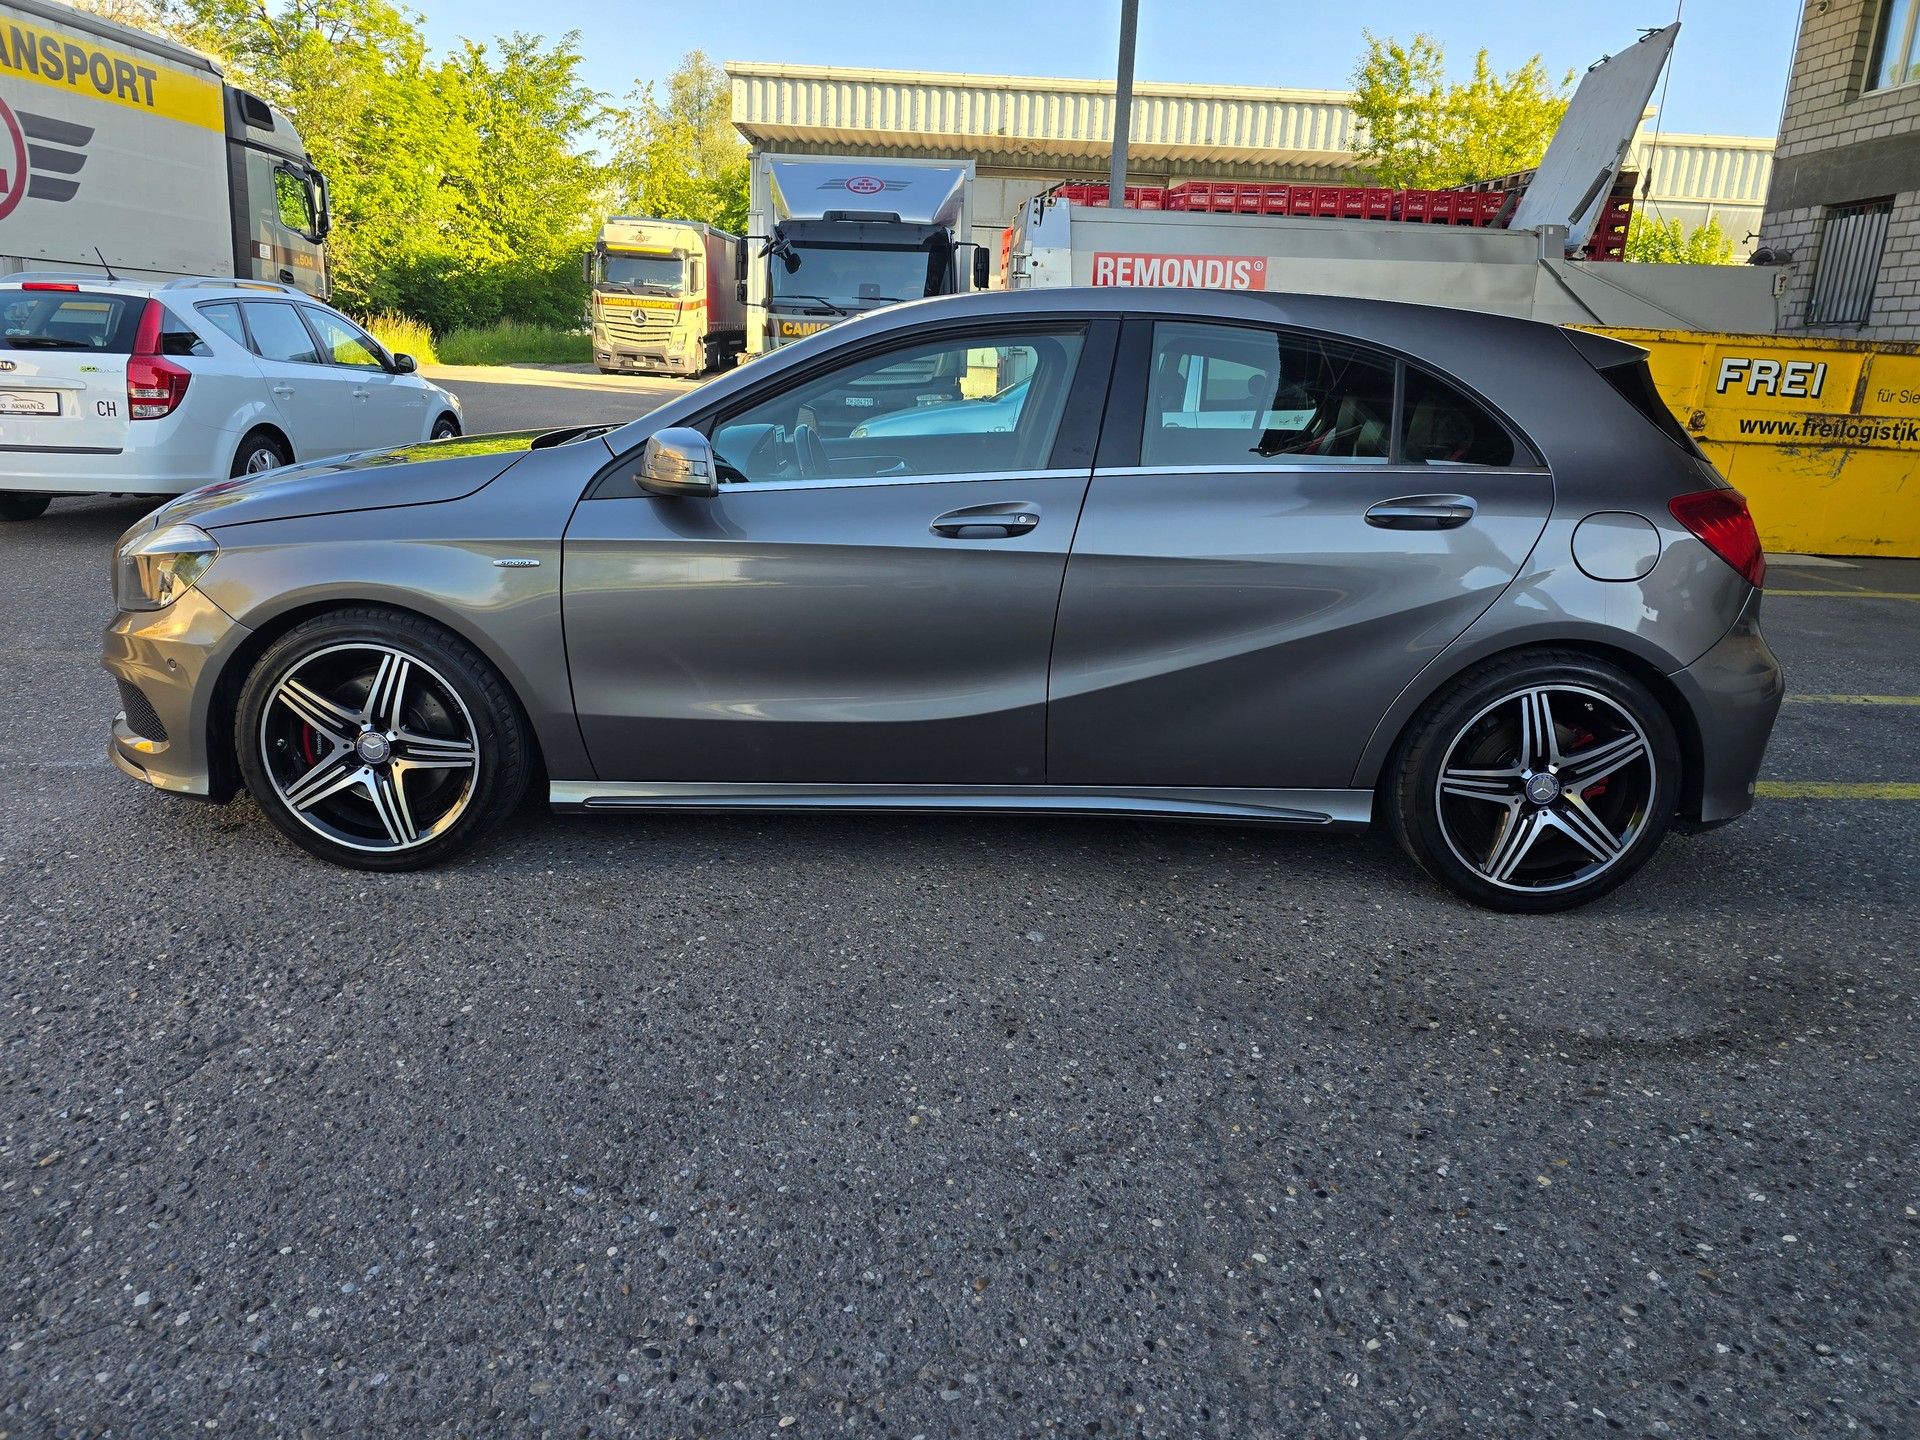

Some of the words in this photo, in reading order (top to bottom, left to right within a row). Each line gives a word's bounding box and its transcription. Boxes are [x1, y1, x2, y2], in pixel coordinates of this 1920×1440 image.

[603, 297, 632, 306] CAMION
[633, 300, 676, 309] TRANSPORT
[1716, 356, 1828, 400] FREI
[1877, 388, 1896, 403] für
[1899, 389, 1920, 404] Sie
[96, 400, 118, 417] CH
